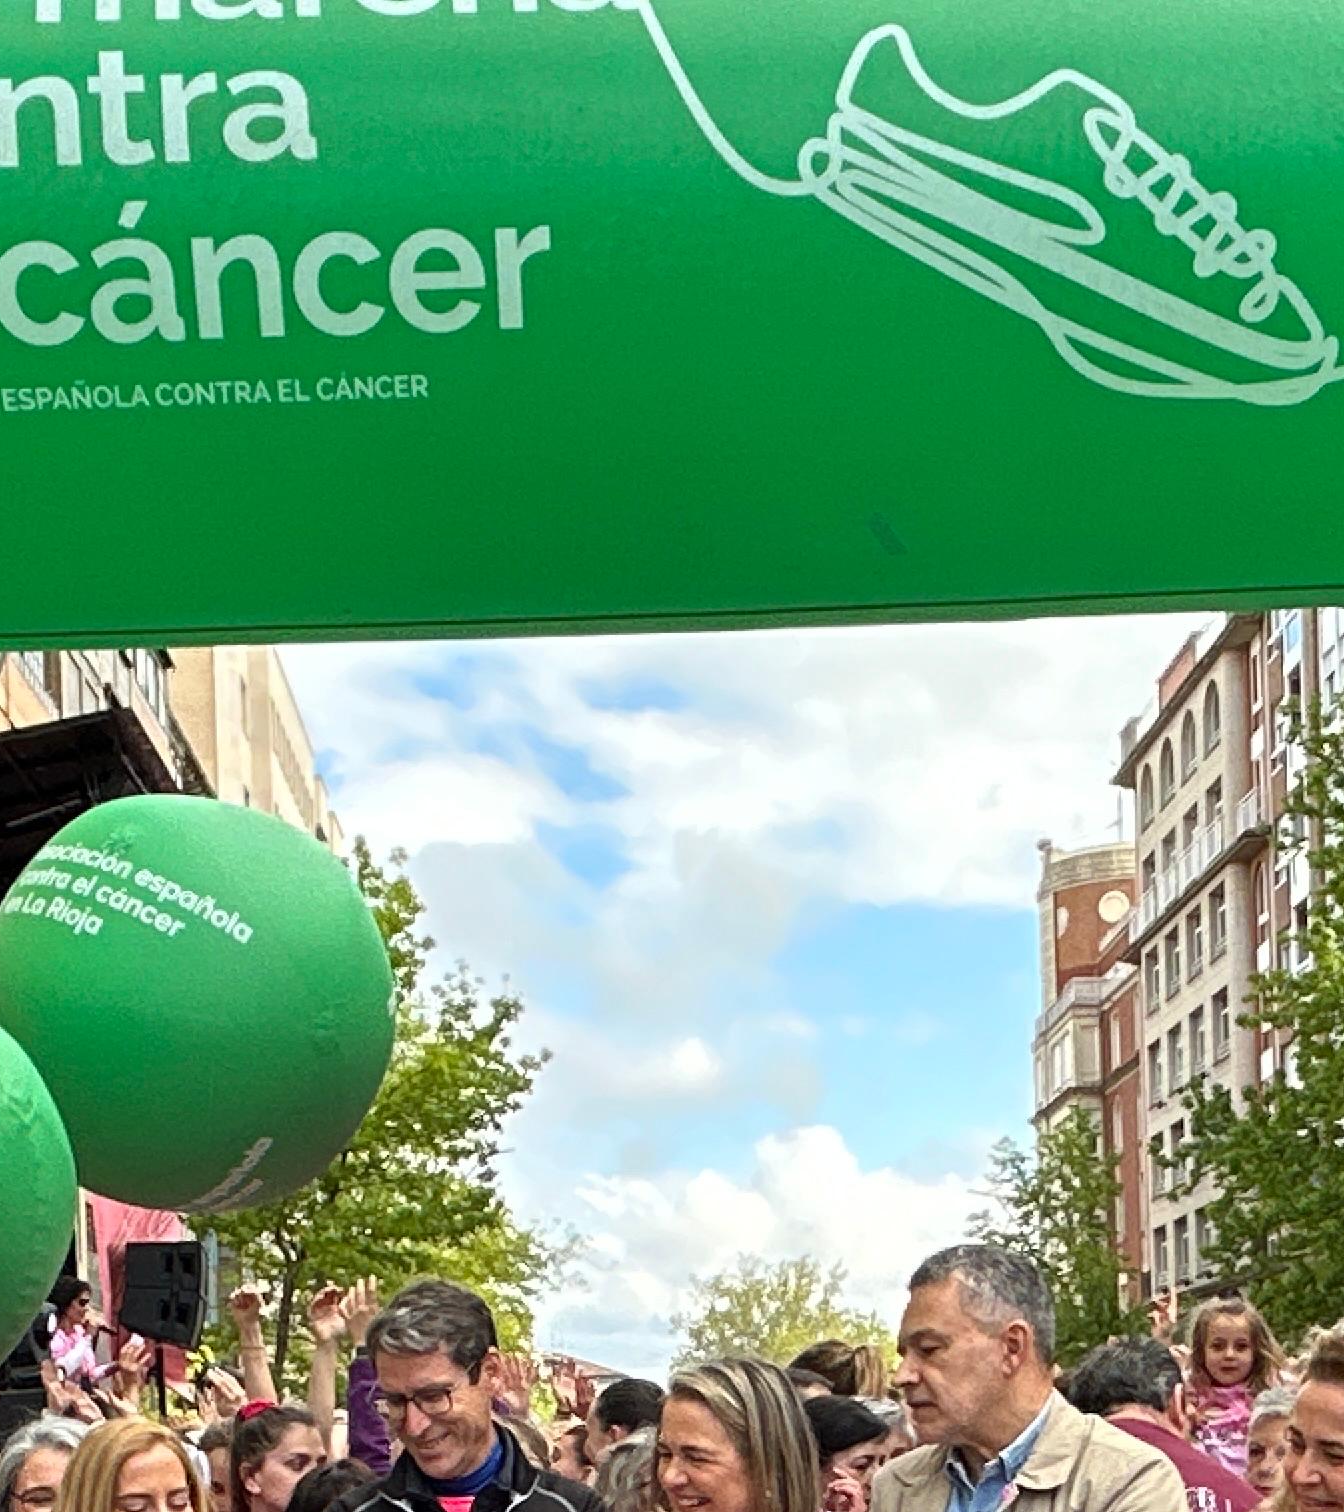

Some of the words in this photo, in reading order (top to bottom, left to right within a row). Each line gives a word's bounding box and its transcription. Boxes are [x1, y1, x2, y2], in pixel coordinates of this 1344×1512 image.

[2, 381, 149, 411] ESPAÑOLA
[155, 380, 270, 406] CONTRA
[278, 378, 310, 403] EL
[316, 371, 429, 401] CÁNCER
[23, 892, 46, 916] La
[45, 896, 104, 935] Rioja
[72, 875, 98, 897] el
[95, 885, 185, 936] cáncer
[134, 867, 253, 944] española
